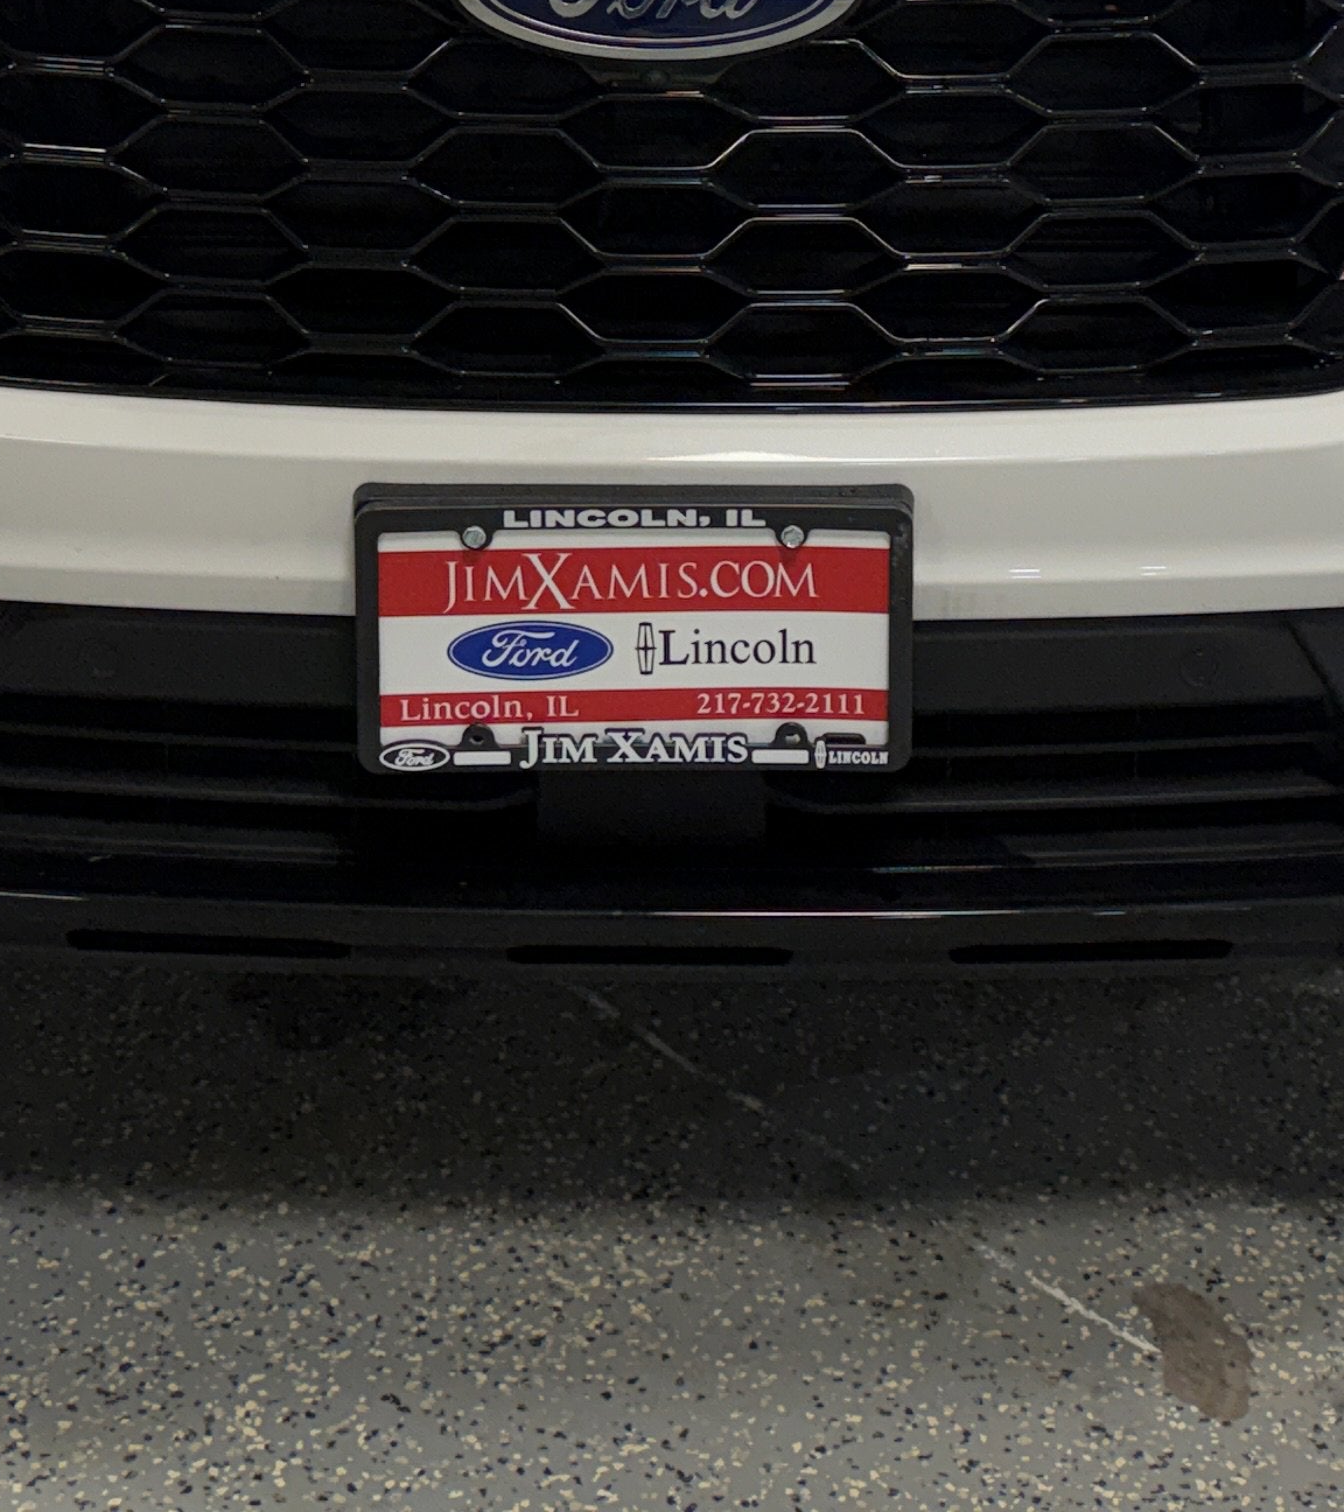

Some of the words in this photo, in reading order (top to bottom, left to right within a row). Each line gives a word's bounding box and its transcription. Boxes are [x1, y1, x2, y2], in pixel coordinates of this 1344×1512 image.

[502, 509, 712, 530] LINCOLN,
[725, 508, 768, 527] IL
[481, 629, 580, 670] Ford
[658, 629, 818, 667] Lincoln
[399, 696, 534, 722] Lincoln,
[546, 696, 581, 719] IL
[696, 693, 866, 716] 217-732-2111
[395, 748, 436, 768] Ford
[605, 728, 750, 765] XAMIS
[829, 752, 890, 765] LINCOLN
